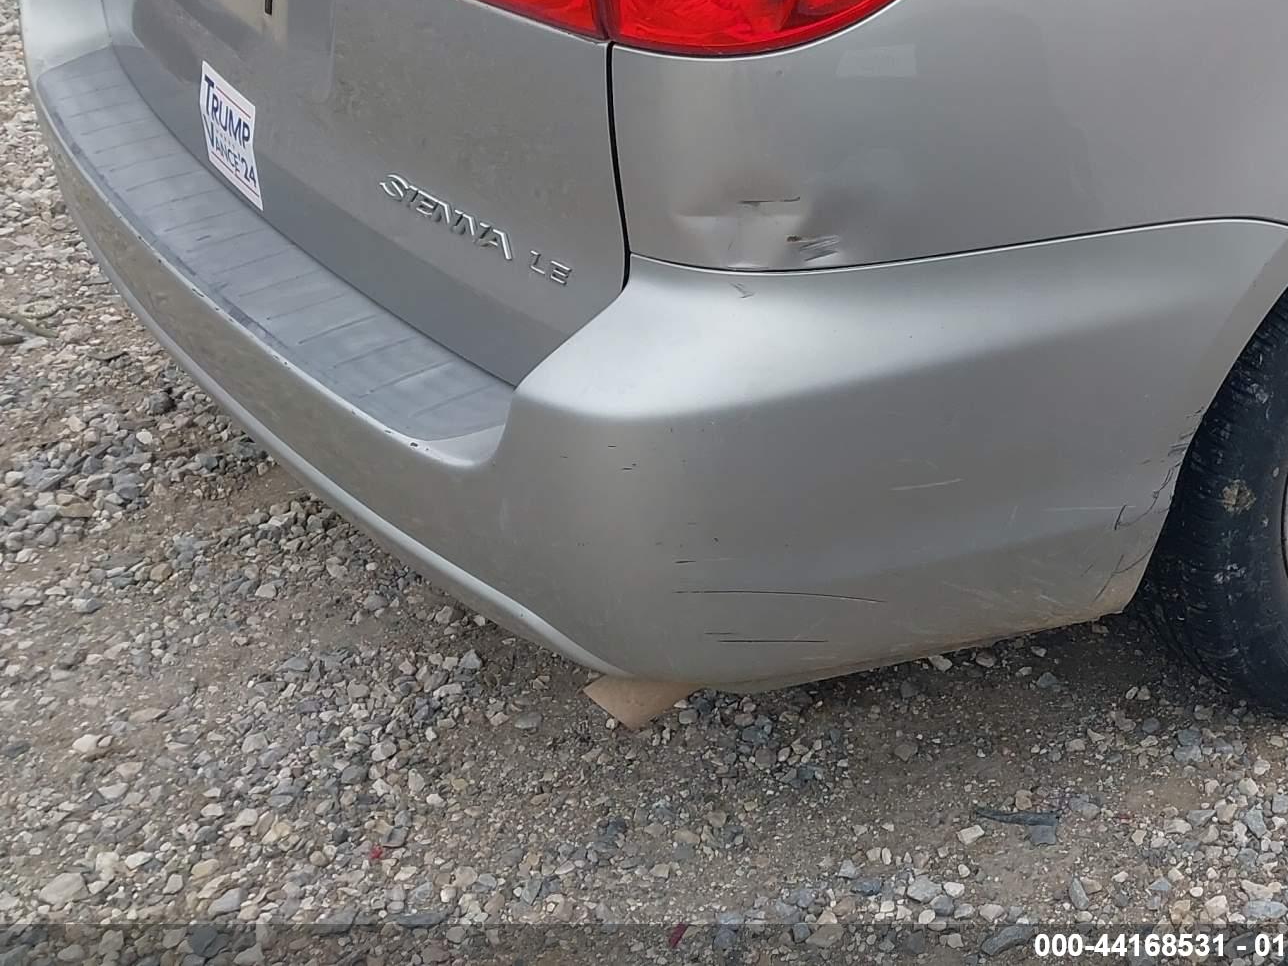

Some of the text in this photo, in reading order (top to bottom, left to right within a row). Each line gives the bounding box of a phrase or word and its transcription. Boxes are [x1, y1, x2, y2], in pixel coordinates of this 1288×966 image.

[204, 74, 251, 149] TRUMP
[378, 173, 573, 286] SIENNA LE
